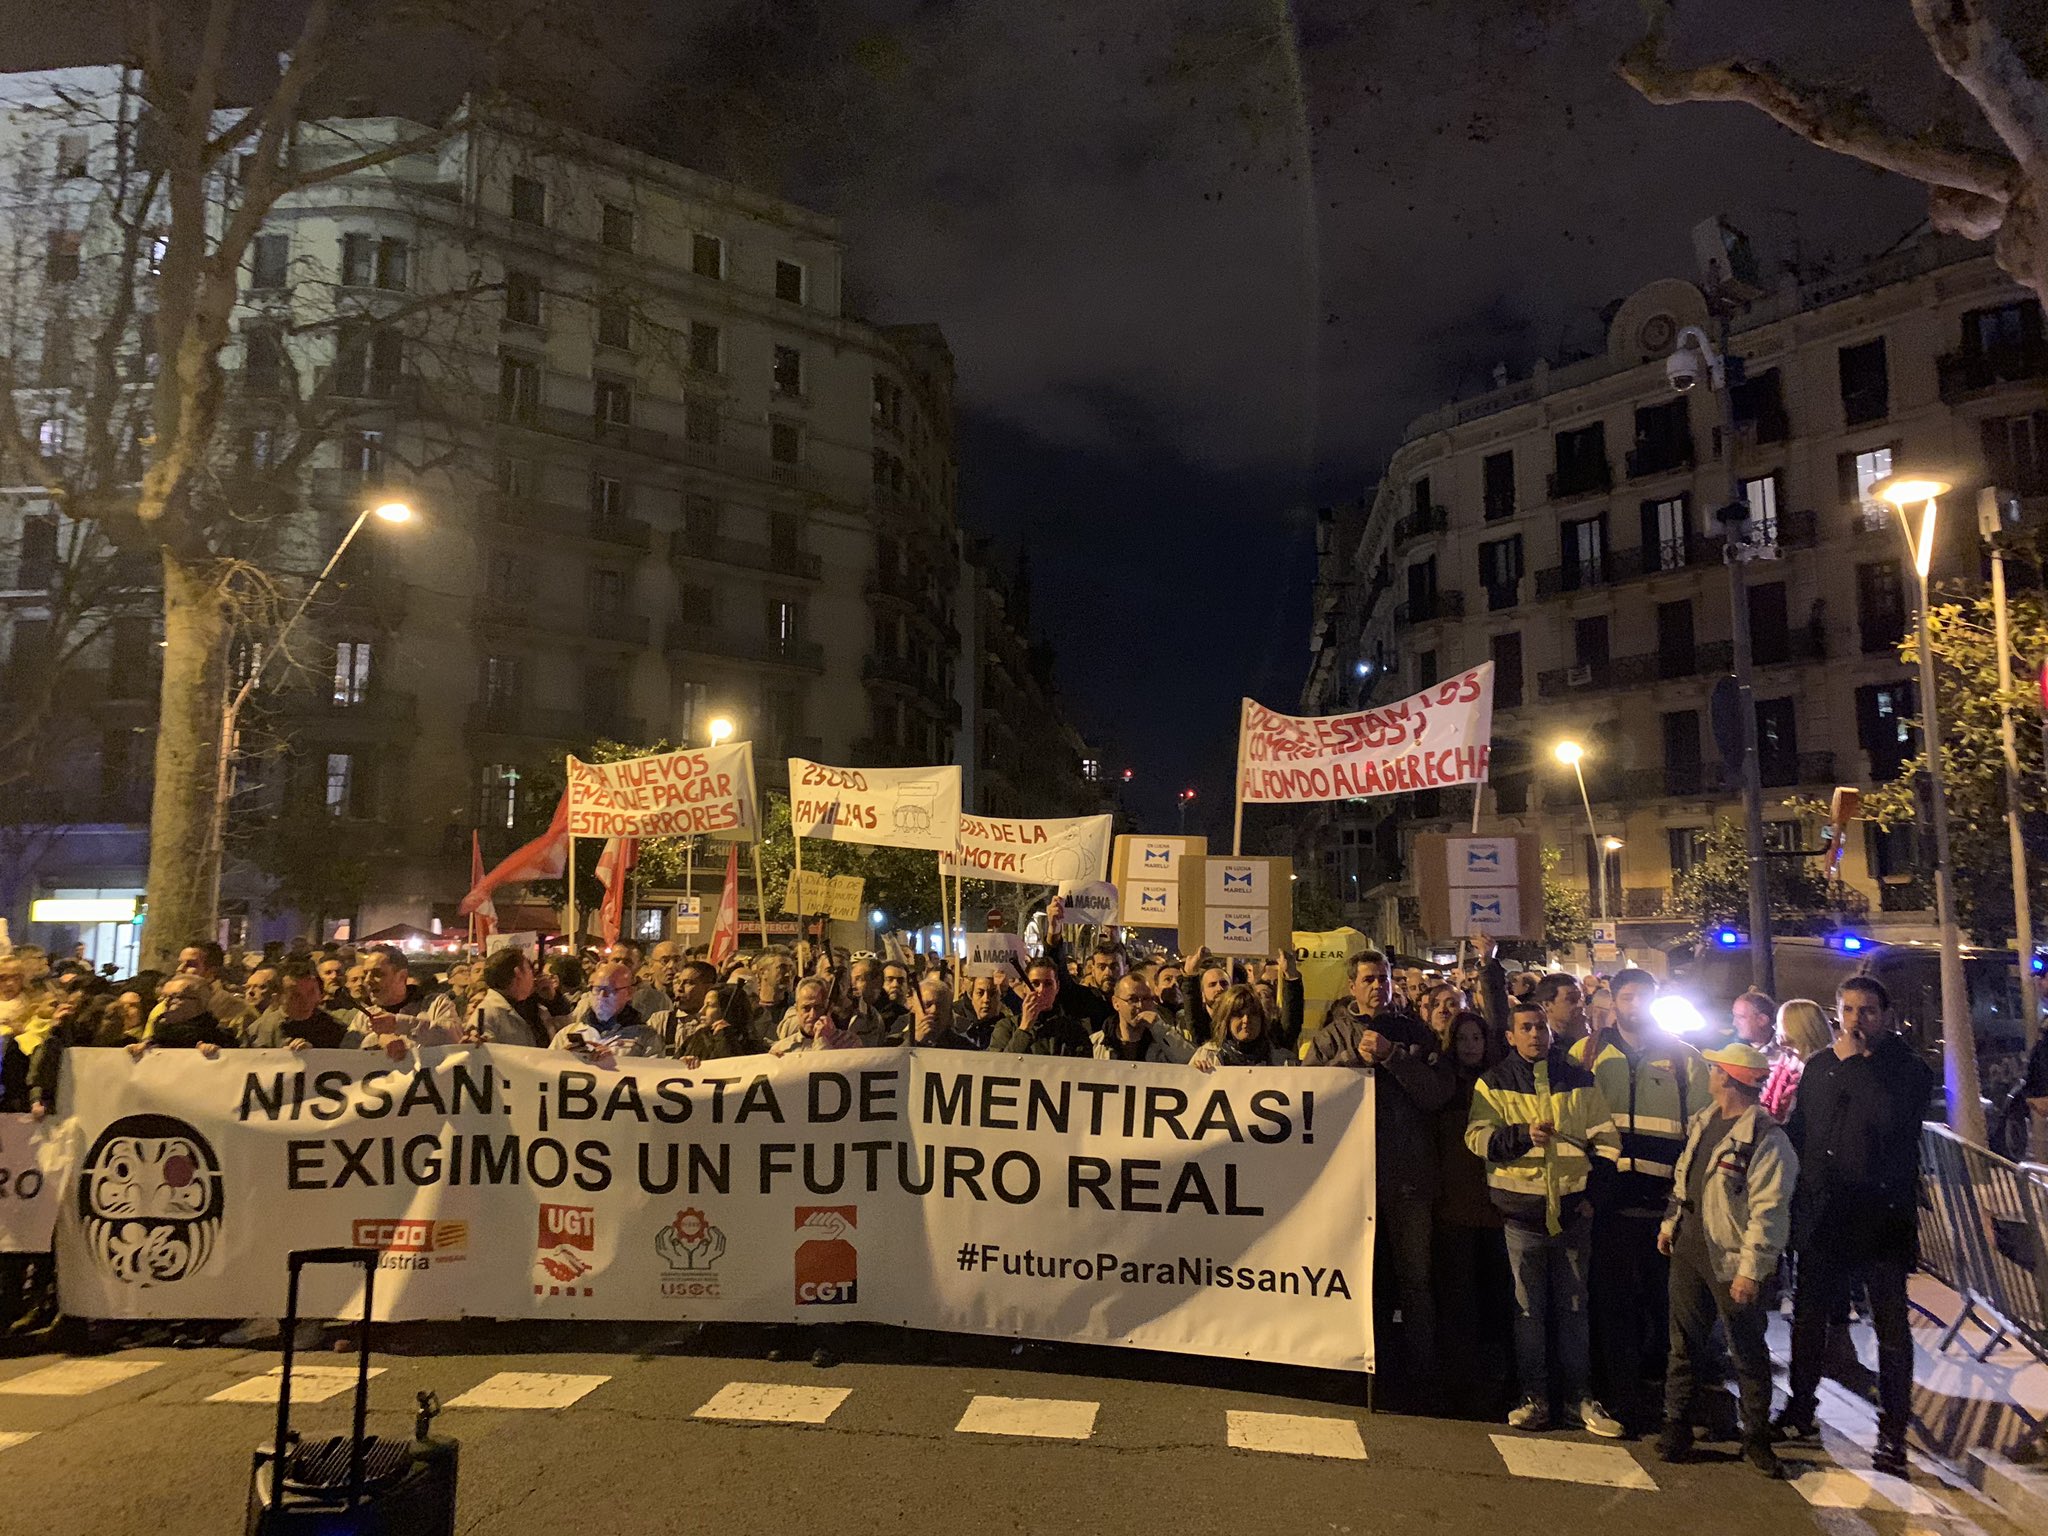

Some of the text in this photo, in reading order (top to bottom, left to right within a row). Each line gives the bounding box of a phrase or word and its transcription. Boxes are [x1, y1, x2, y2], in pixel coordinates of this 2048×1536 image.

[1419, 672, 1481, 708] LOS
[616, 753, 709, 788] HUEVOS
[1262, 767, 1330, 799] FONDO
[653, 774, 733, 807] PAGAR
[641, 798, 747, 836] ERRORES!
[795, 800, 878, 829] FAMILIAS
[990, 823, 1017, 843] DE
[1018, 824, 1048, 844] LA
[1075, 895, 1111, 910] MAGNA
[238, 1064, 1314, 1144] NISSAN: ¡BASTA DE MENTIRAS!
[287, 1134, 1264, 1216] EXIGIMOS UN FUTURO REAL
[358, 1225, 426, 1245] CCOO
[548, 1207, 595, 1236] UGT
[957, 1243, 1351, 1300] #FuturoParaNissanYA
[799, 1281, 853, 1300] CGT
